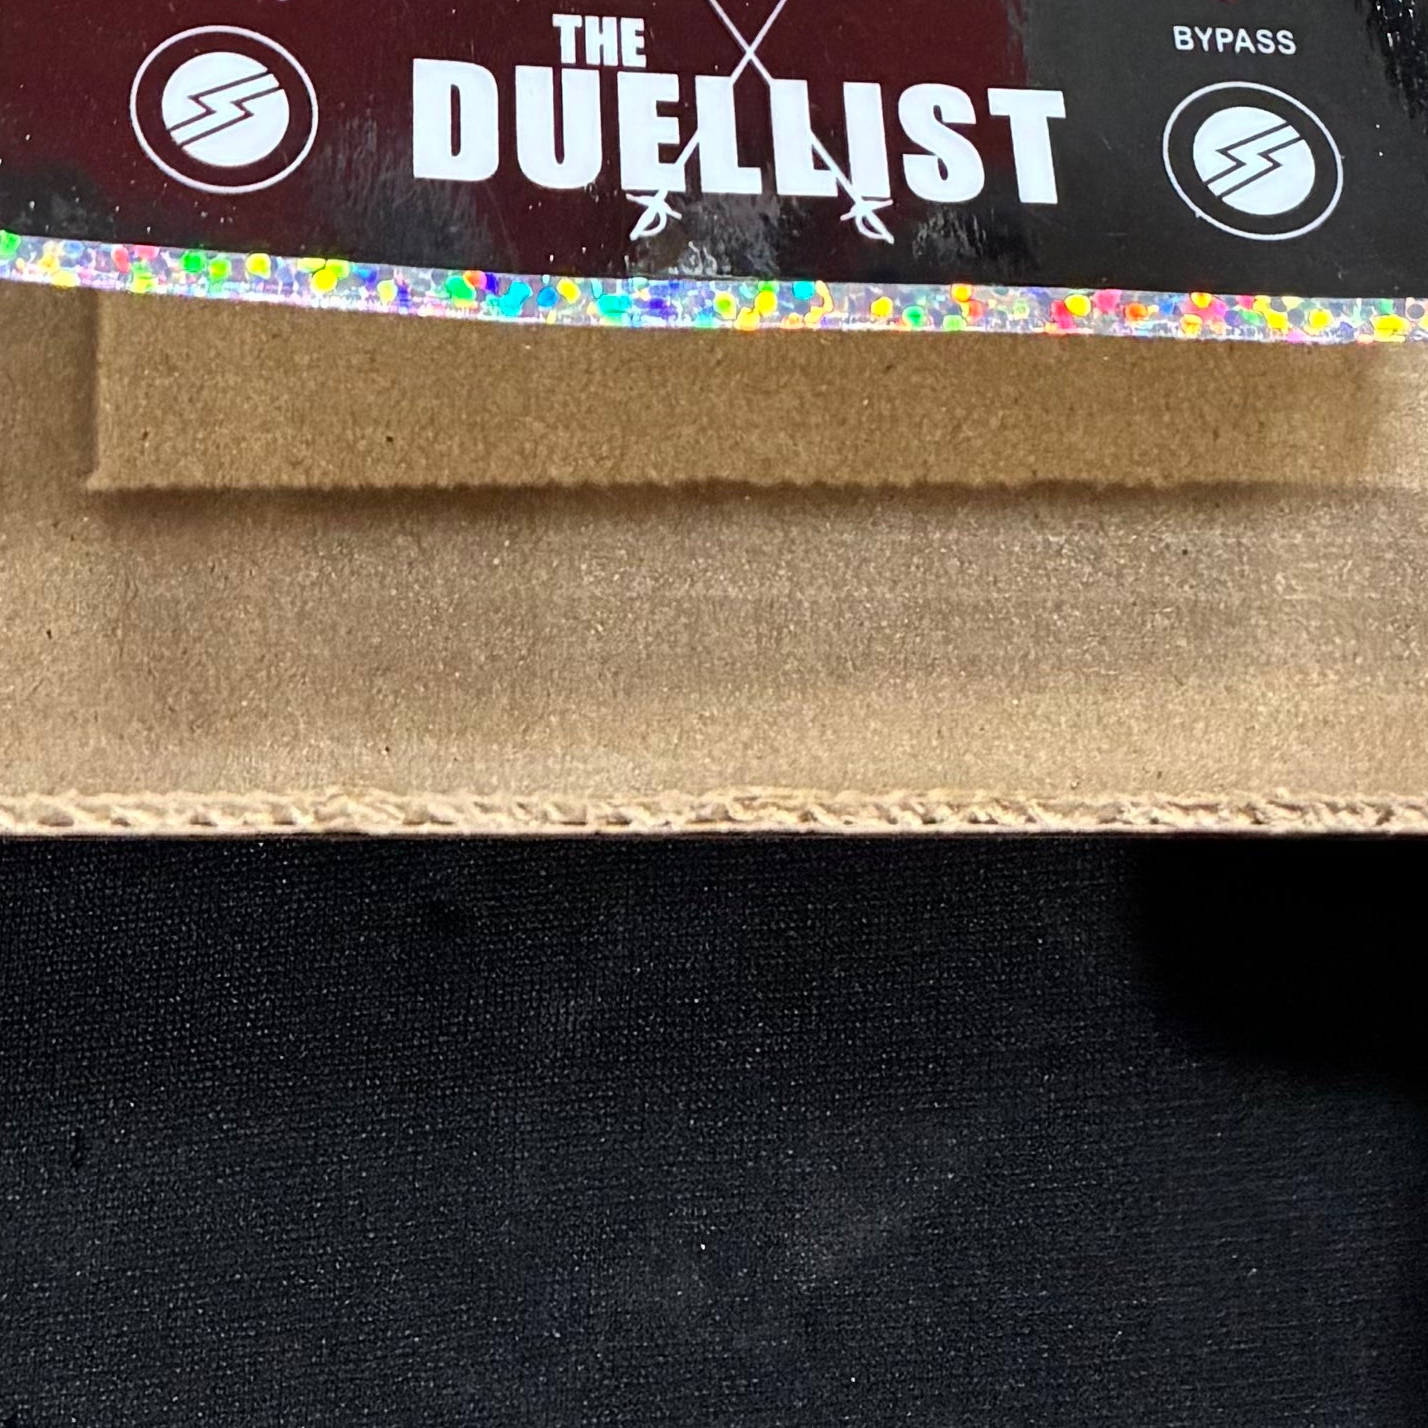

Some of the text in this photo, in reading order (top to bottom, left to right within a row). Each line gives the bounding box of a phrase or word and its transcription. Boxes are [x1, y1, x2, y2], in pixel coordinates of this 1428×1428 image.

[551, 13, 647, 67] THE
[1172, 25, 1298, 56] BYPASS
[412, 56, 1067, 206] DUELLIST
